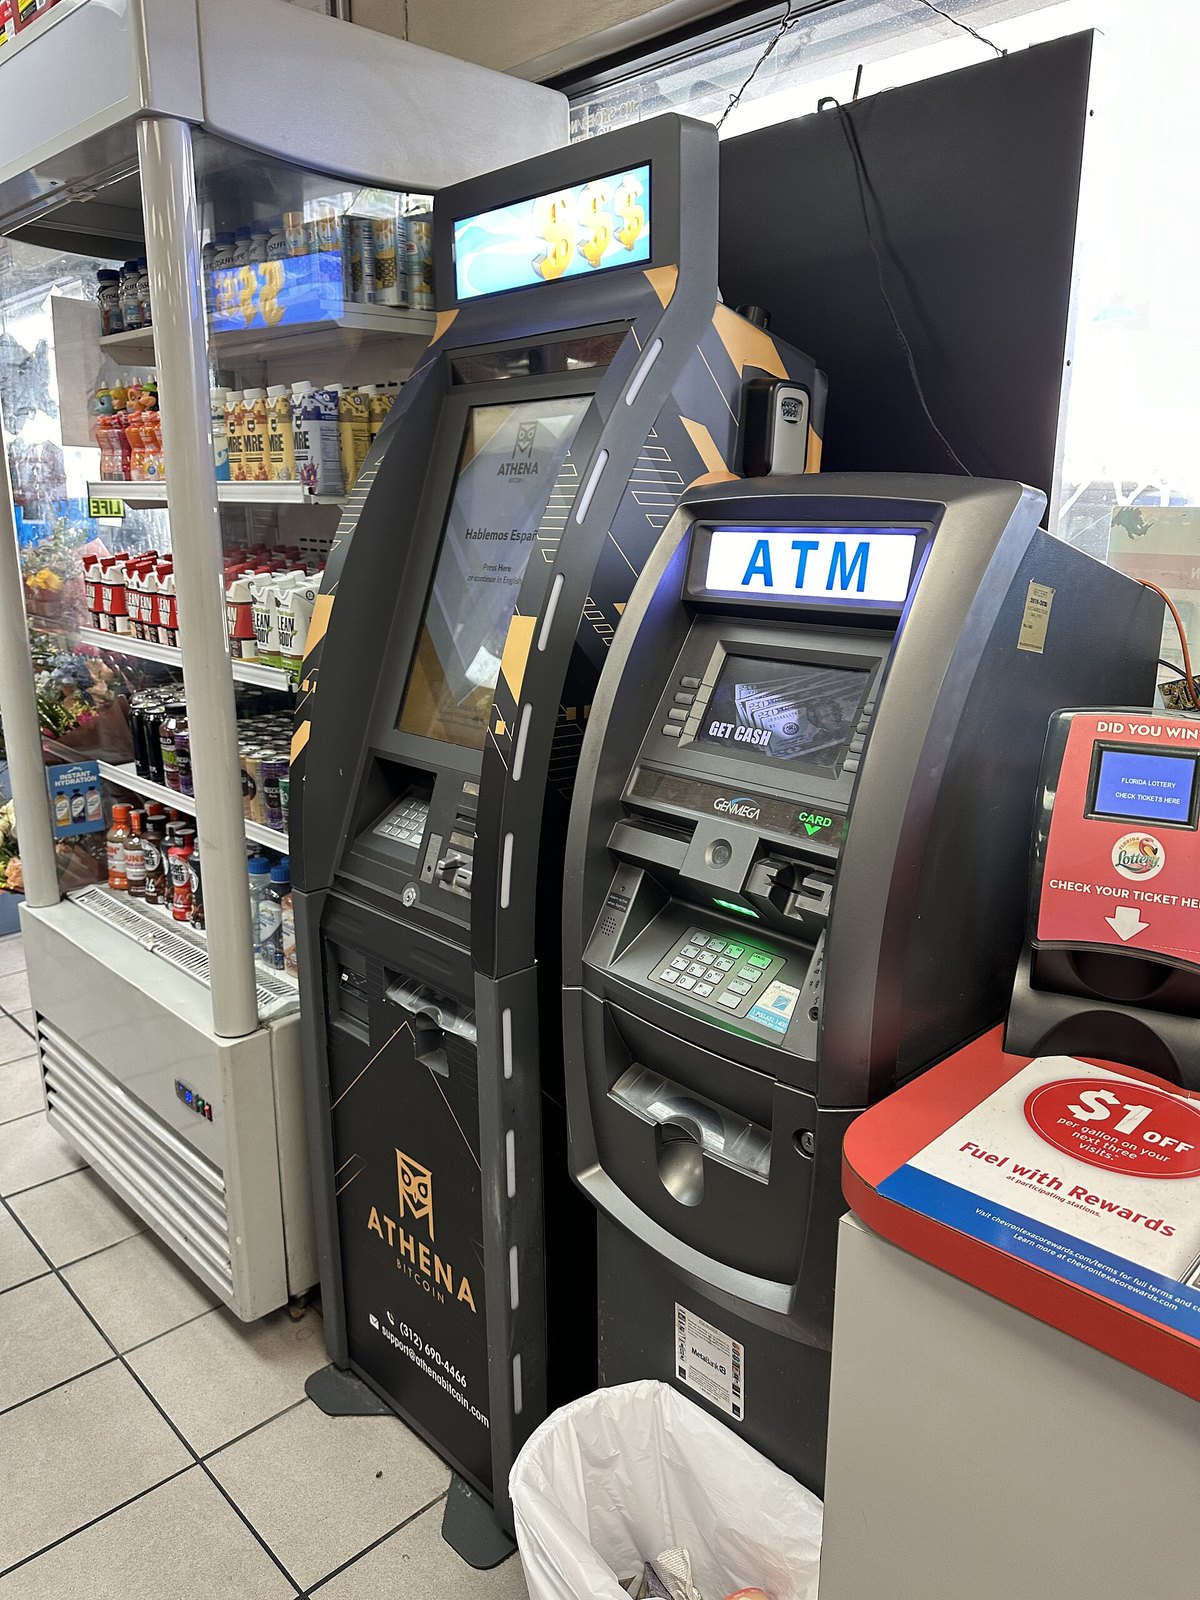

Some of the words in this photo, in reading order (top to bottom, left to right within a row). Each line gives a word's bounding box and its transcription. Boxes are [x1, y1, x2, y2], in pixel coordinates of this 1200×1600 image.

[243, 434, 264, 452] MRE
[269, 433, 284, 452] MRE
[294, 431, 311, 450] MRE
[497, 462, 539, 476] ATHENA
[465, 528, 509, 541] Hablemos
[510, 529, 538, 544] Españ
[482, 562, 498, 571] Press
[498, 564, 511, 572] Here
[741, 539, 871, 593] ATM
[708, 720, 735, 739] GET
[734, 725, 772, 746] CASH
[1097, 721, 1124, 734] DID
[1128, 723, 1162, 737] YOU
[1166, 726, 1200, 740] WIN
[54, 775, 97, 787] HYDRATION
[59, 770, 91, 780] INSTANT
[1121, 777, 1147, 786] FLORIDA
[1148, 780, 1177, 789] LOTTERY
[713, 797, 761, 821] GENMEGA
[1115, 791, 1137, 800] CHECK
[1137, 794, 1163, 803] TICKETS
[1164, 797, 1181, 805] HERE
[798, 811, 832, 828] CARD
[1118, 836, 1140, 850] FLORIDA
[1049, 879, 1092, 894] CHECK
[1095, 885, 1130, 899] YOUR
[1132, 890, 1179, 906] TICKET
[1181, 897, 1200, 909] HE
[1066, 1089, 1154, 1135] $1
[1143, 1131, 1195, 1153] OFF
[1056, 1117, 1080, 1129] per
[1081, 1126, 1119, 1144] gallon
[1121, 1139, 1138, 1151] on
[1140, 1148, 1171, 1162] your
[1072, 1131, 1101, 1146] next
[1103, 1141, 1138, 1160] three
[958, 1141, 1010, 1169] Fuel
[1011, 1163, 1064, 1191] with
[1068, 1185, 1177, 1237] Rewards
[1006, 1175, 1015, 1183] at
[1015, 1178, 1066, 1203] participating
[1066, 1200, 1102, 1218] stations.
[367, 1206, 477, 1314] ATHENA
[975, 1207, 992, 1219] Visit
[991, 1215, 1118, 1275] chevrontexacorewards.com/terms
[1119, 1271, 1133, 1281] for
[1133, 1277, 1148, 1288] full
[1148, 1284, 1174, 1300] terms
[1174, 1296, 1192, 1308] and
[396, 1258, 446, 1304] BITCOIN
[1013, 1232, 1035, 1247] Learn
[1036, 1242, 1057, 1256] more
[1056, 1252, 1067, 1261] at
[1066, 1257, 1178, 1311] chevrontexacorewards.com
[400, 1321, 423, 1350] (312)
[424, 1343, 467, 1388] 690-4466
[381, 1326, 490, 1428] support@athenabitcoin.com
